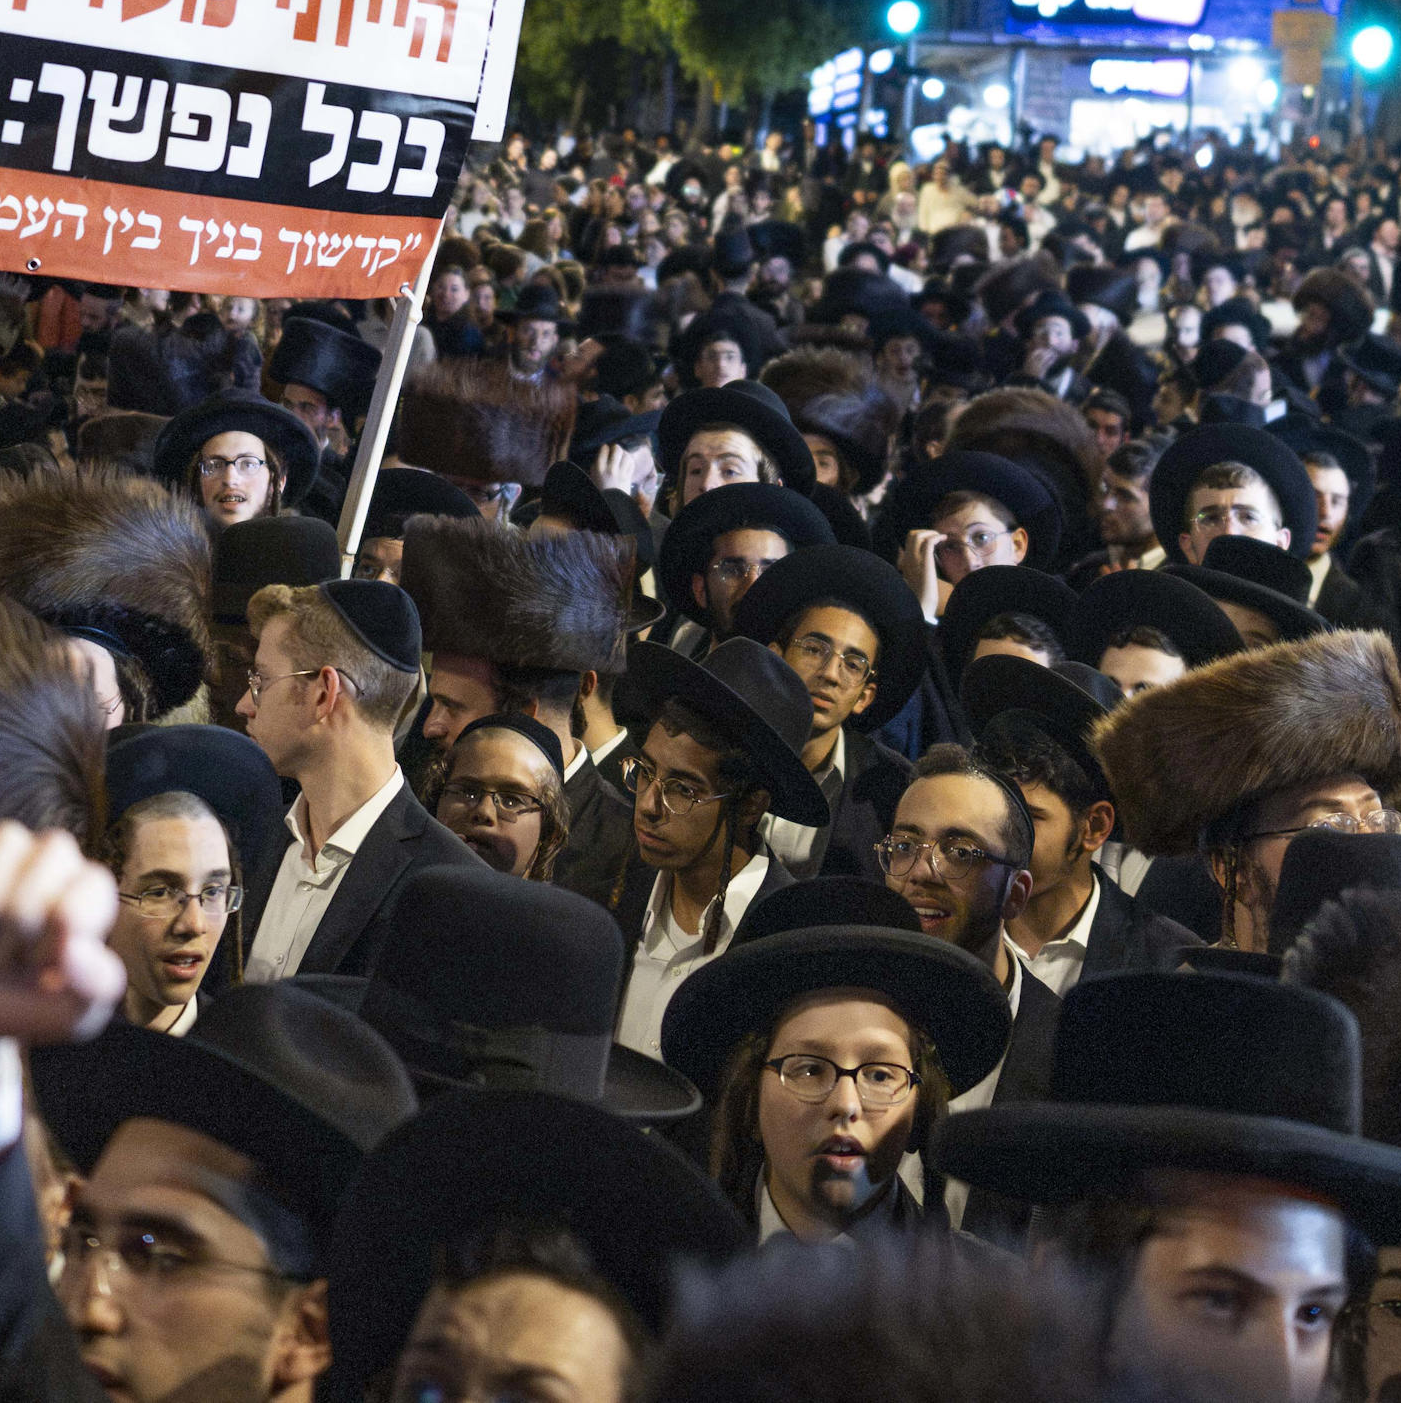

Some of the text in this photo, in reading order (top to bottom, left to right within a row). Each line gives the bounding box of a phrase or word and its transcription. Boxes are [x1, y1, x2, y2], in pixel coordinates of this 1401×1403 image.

[0, 57, 275, 180] נפשך:
[300, 78, 447, 199] בכל
[102, 203, 163, 256] בין
[177, 213, 265, 265] בניך
